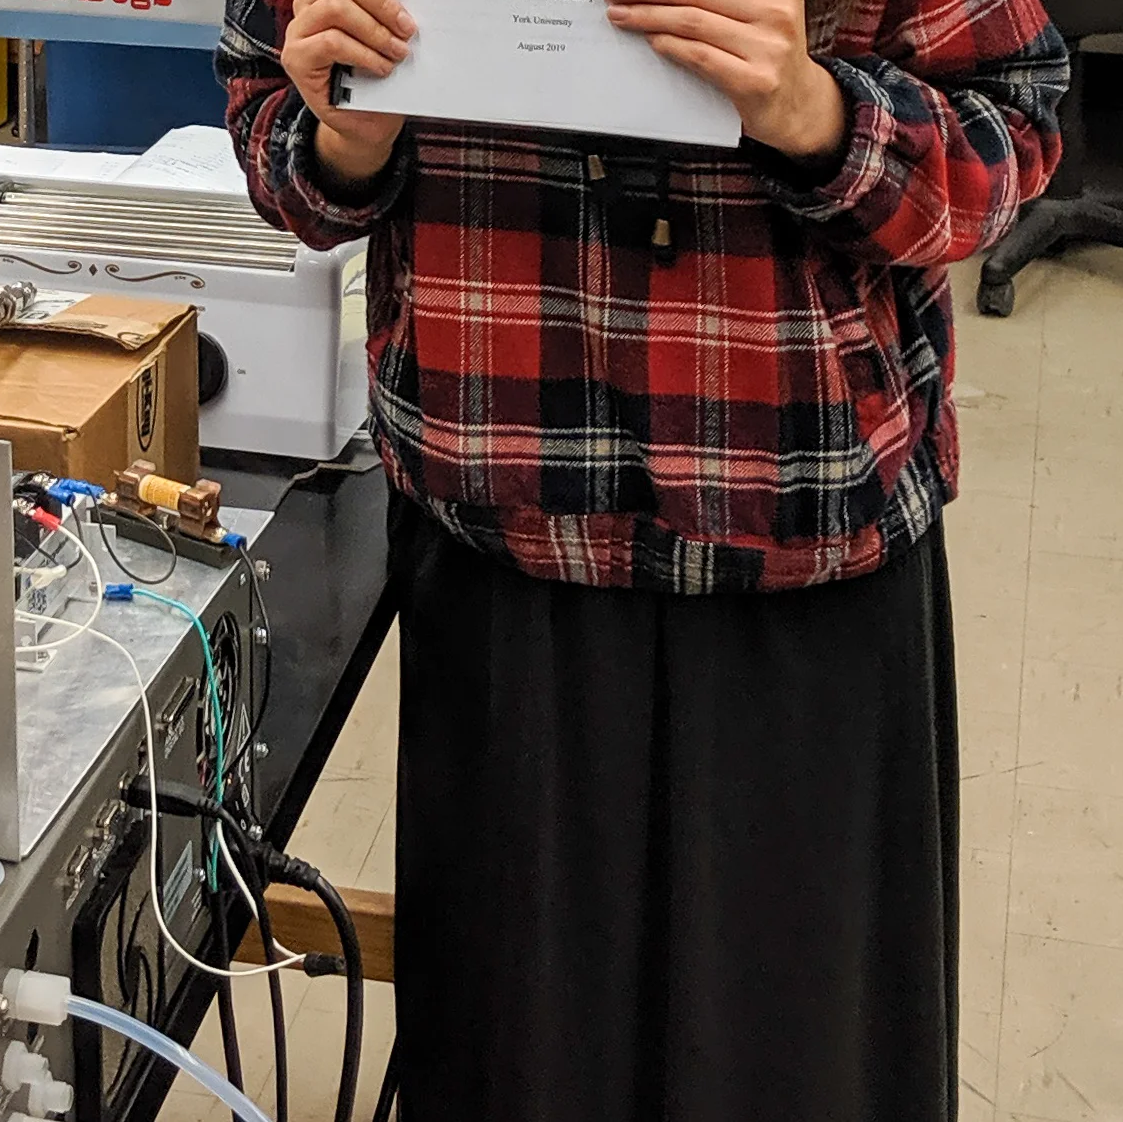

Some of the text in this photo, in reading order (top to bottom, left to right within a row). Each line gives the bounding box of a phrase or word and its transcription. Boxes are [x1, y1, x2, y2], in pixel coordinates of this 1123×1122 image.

[513, 14, 573, 27] York University
[517, 42, 566, 52] August 2019
